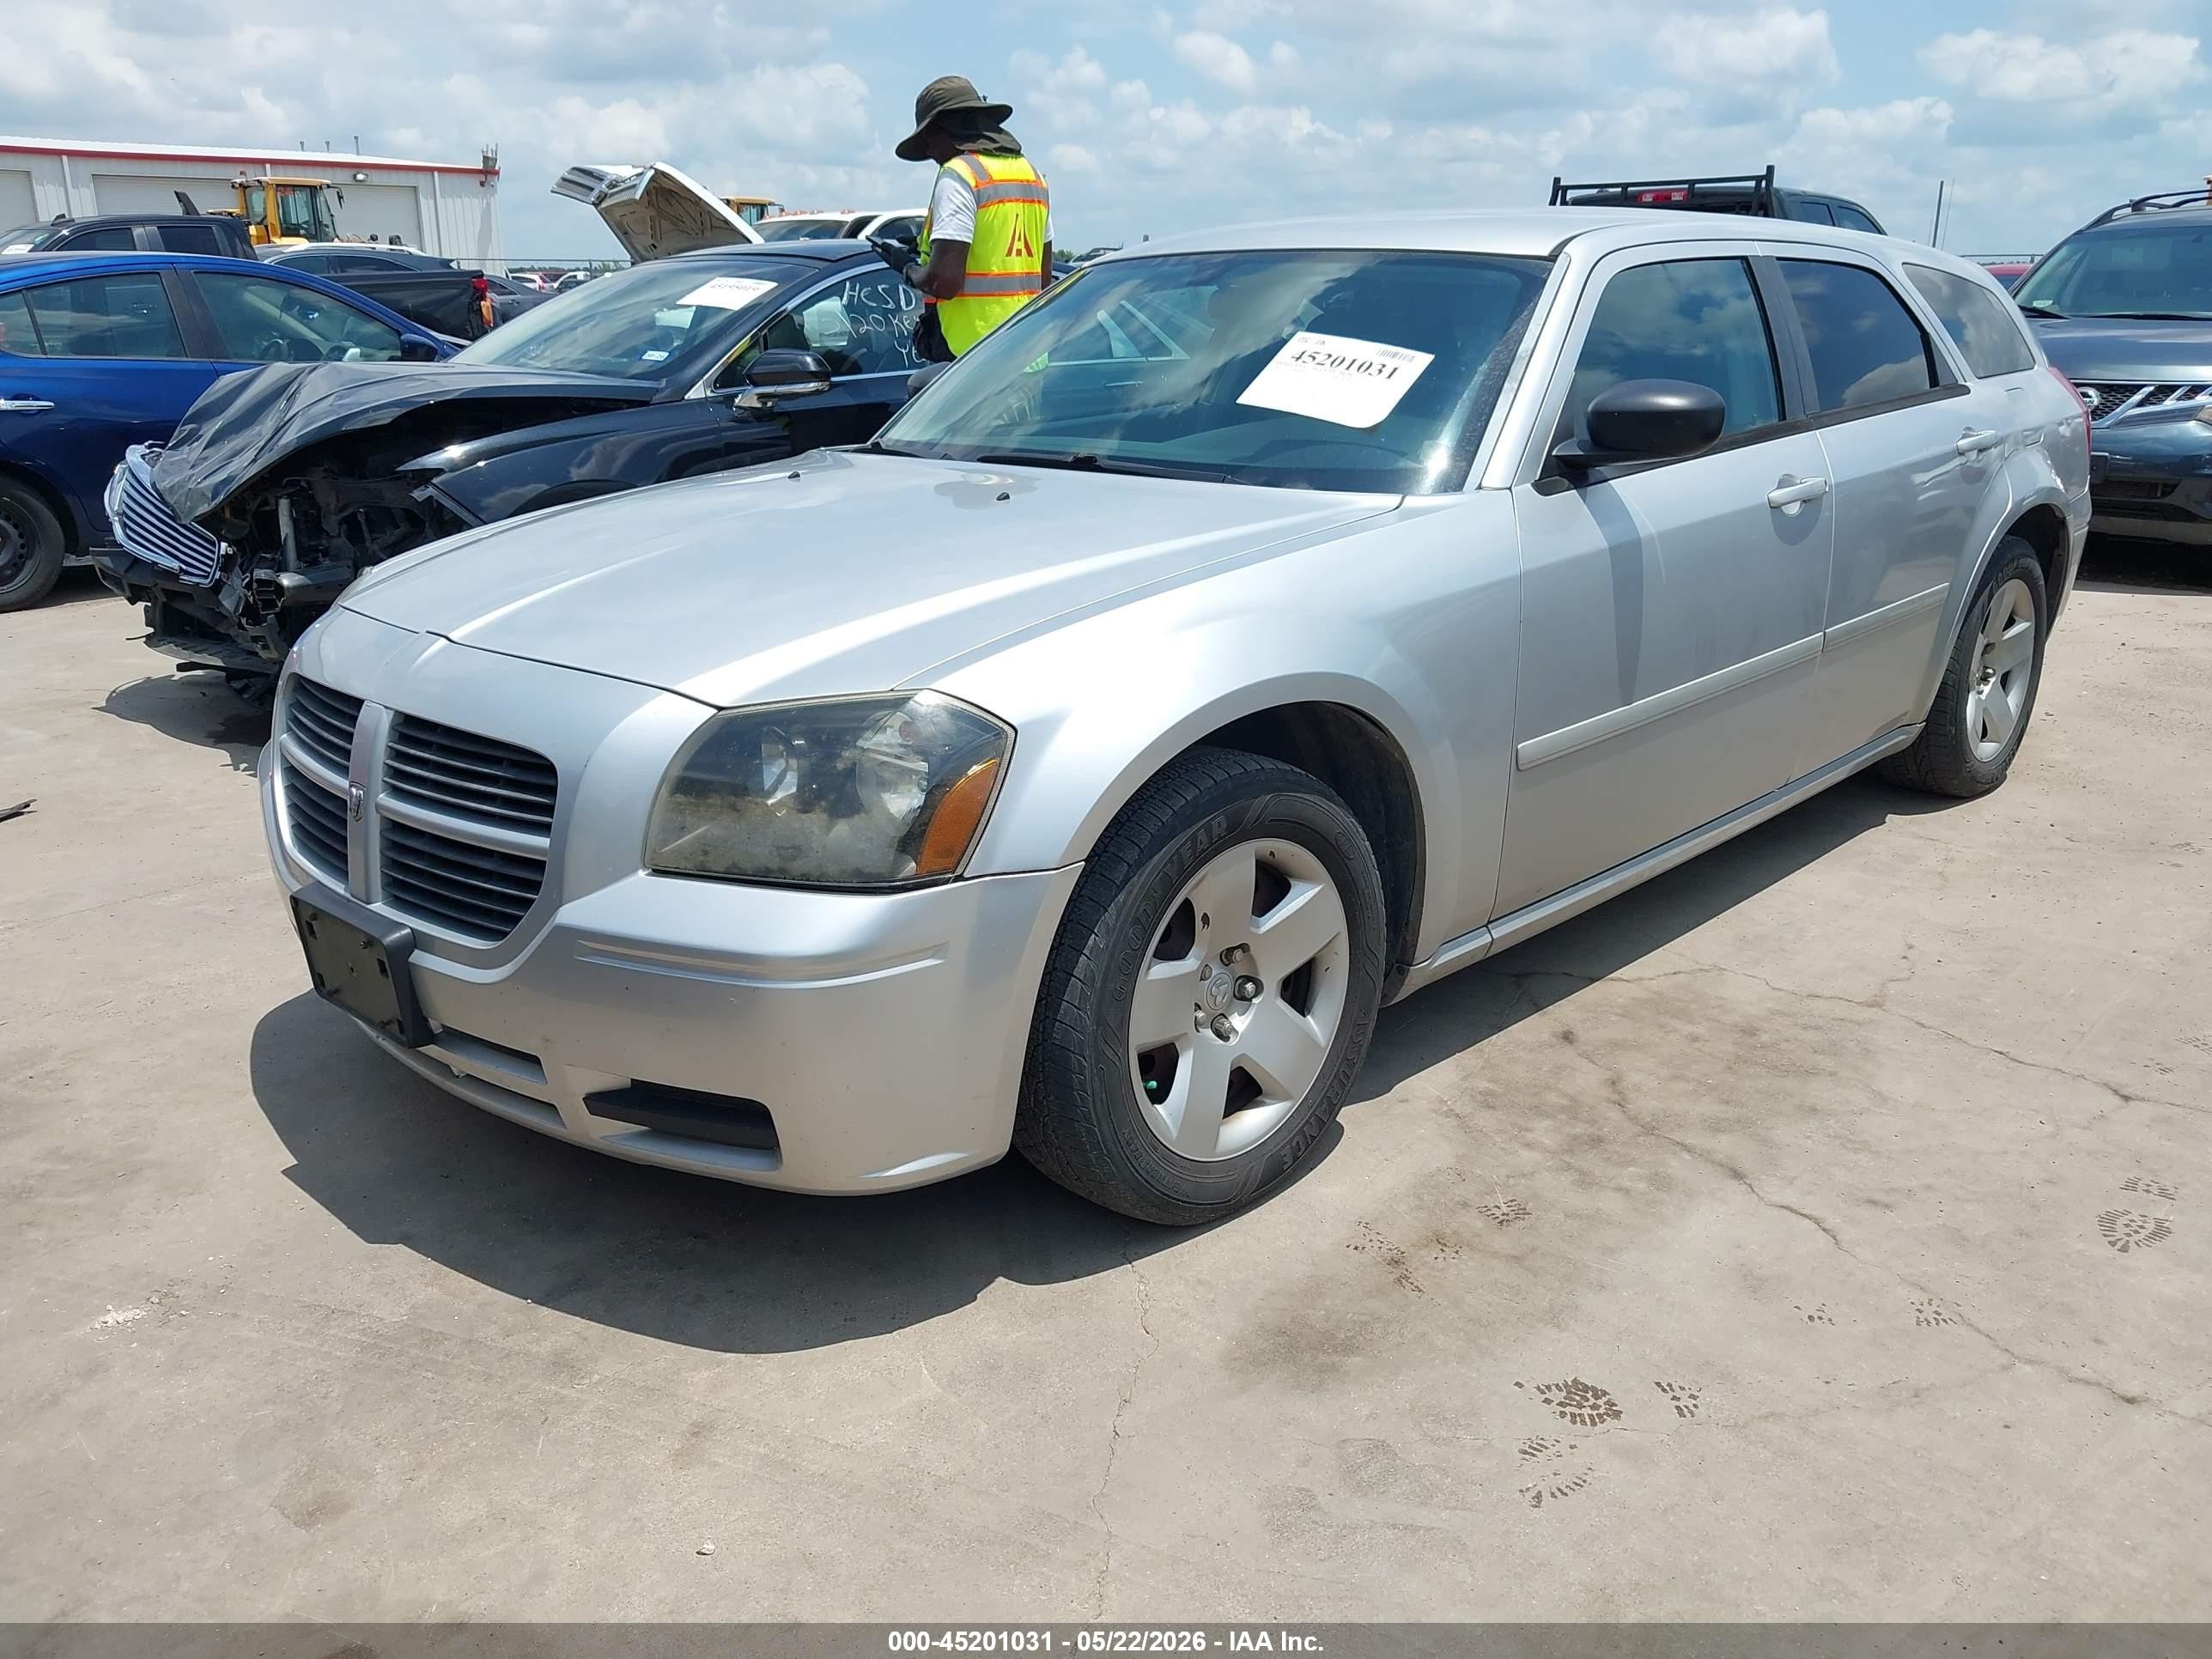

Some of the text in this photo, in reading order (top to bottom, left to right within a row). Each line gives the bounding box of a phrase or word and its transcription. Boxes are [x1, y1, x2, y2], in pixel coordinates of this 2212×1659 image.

[1291, 349, 1400, 380] 45201031
[1113, 816, 1228, 1001] GOODYEAR
[1284, 1007, 1370, 1170] ASSURANCE
